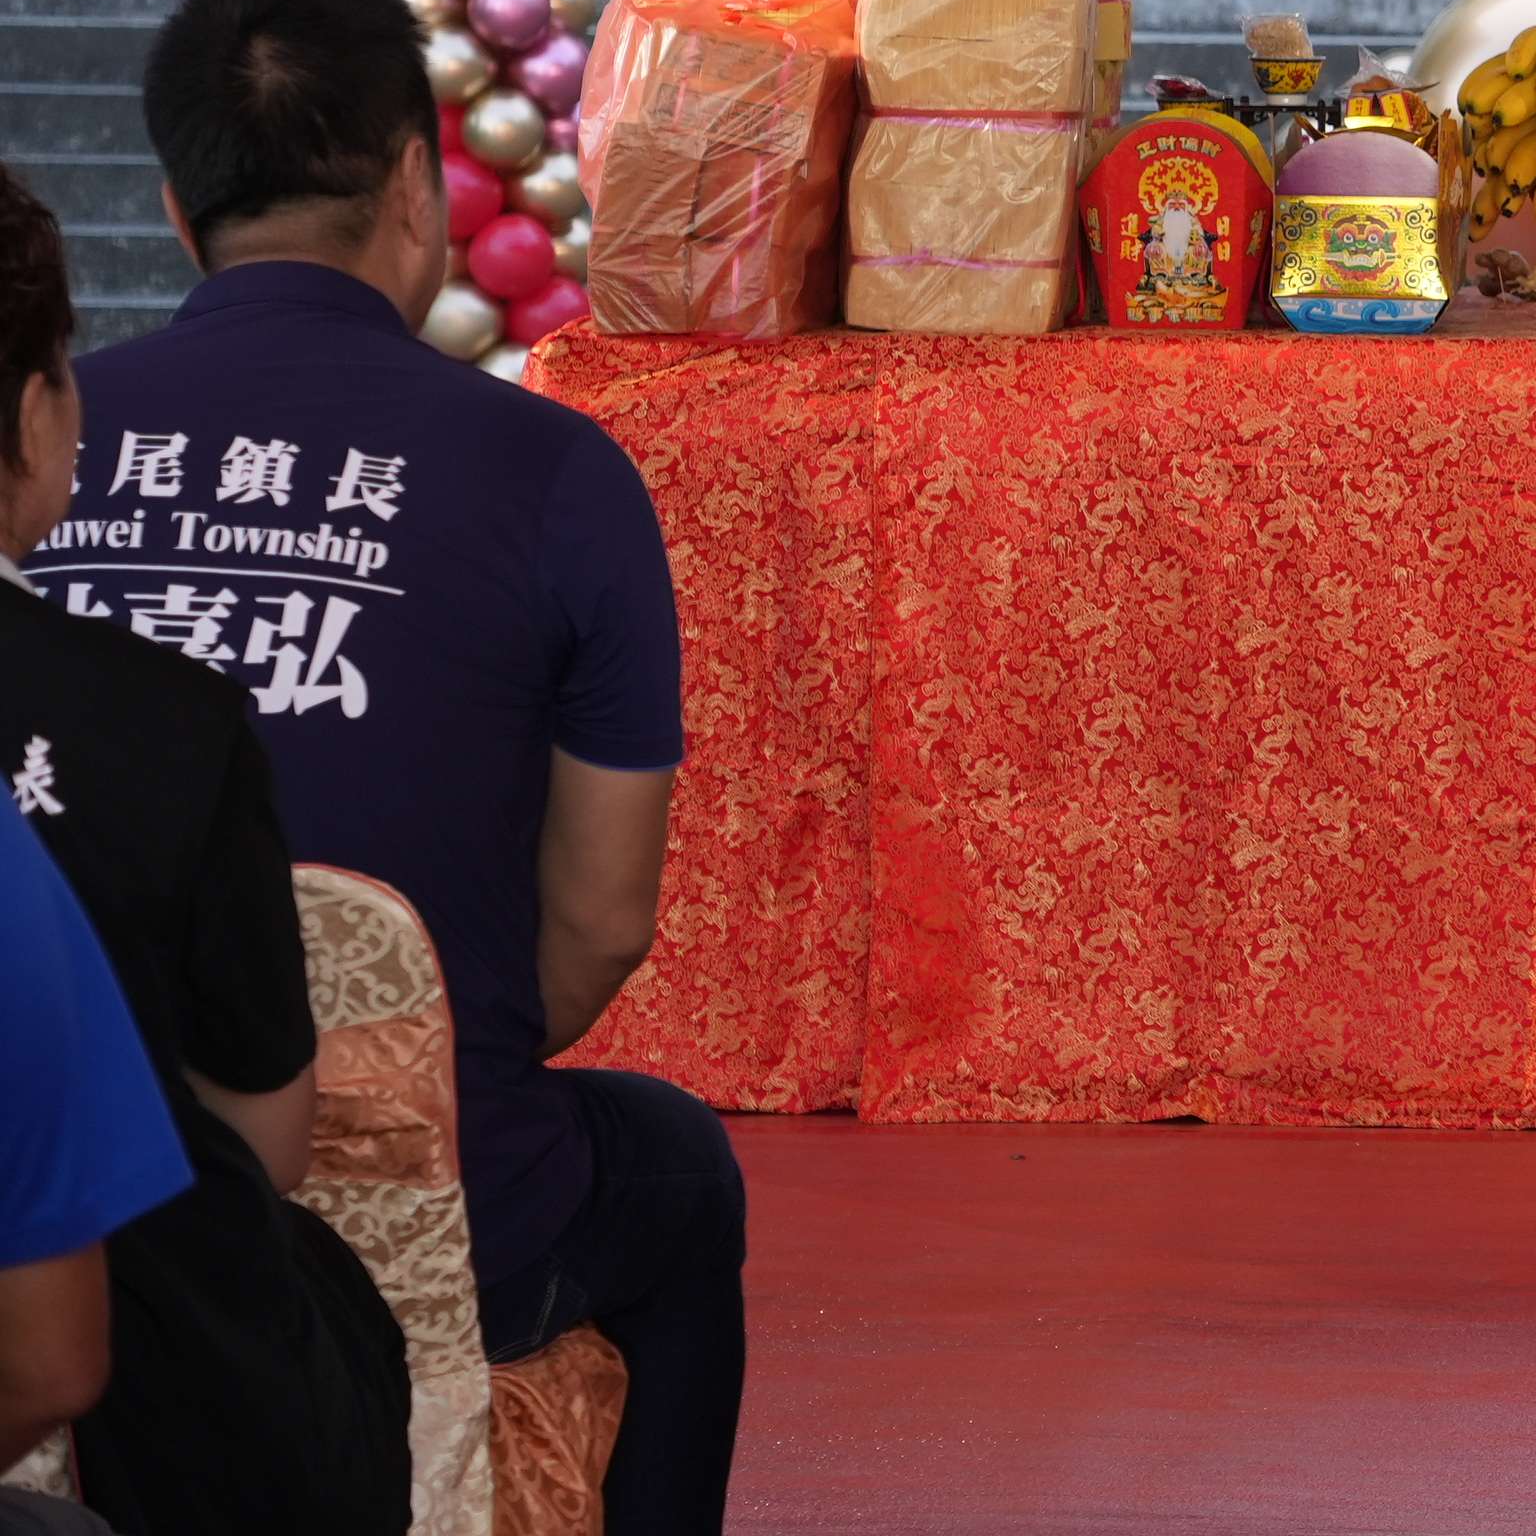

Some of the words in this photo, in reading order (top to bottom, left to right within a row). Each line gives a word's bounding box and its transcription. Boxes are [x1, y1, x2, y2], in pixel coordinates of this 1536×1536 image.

[71, 430, 408, 522] 尾鎮長
[33, 509, 147, 551] uwei
[171, 511, 390, 577] Township
